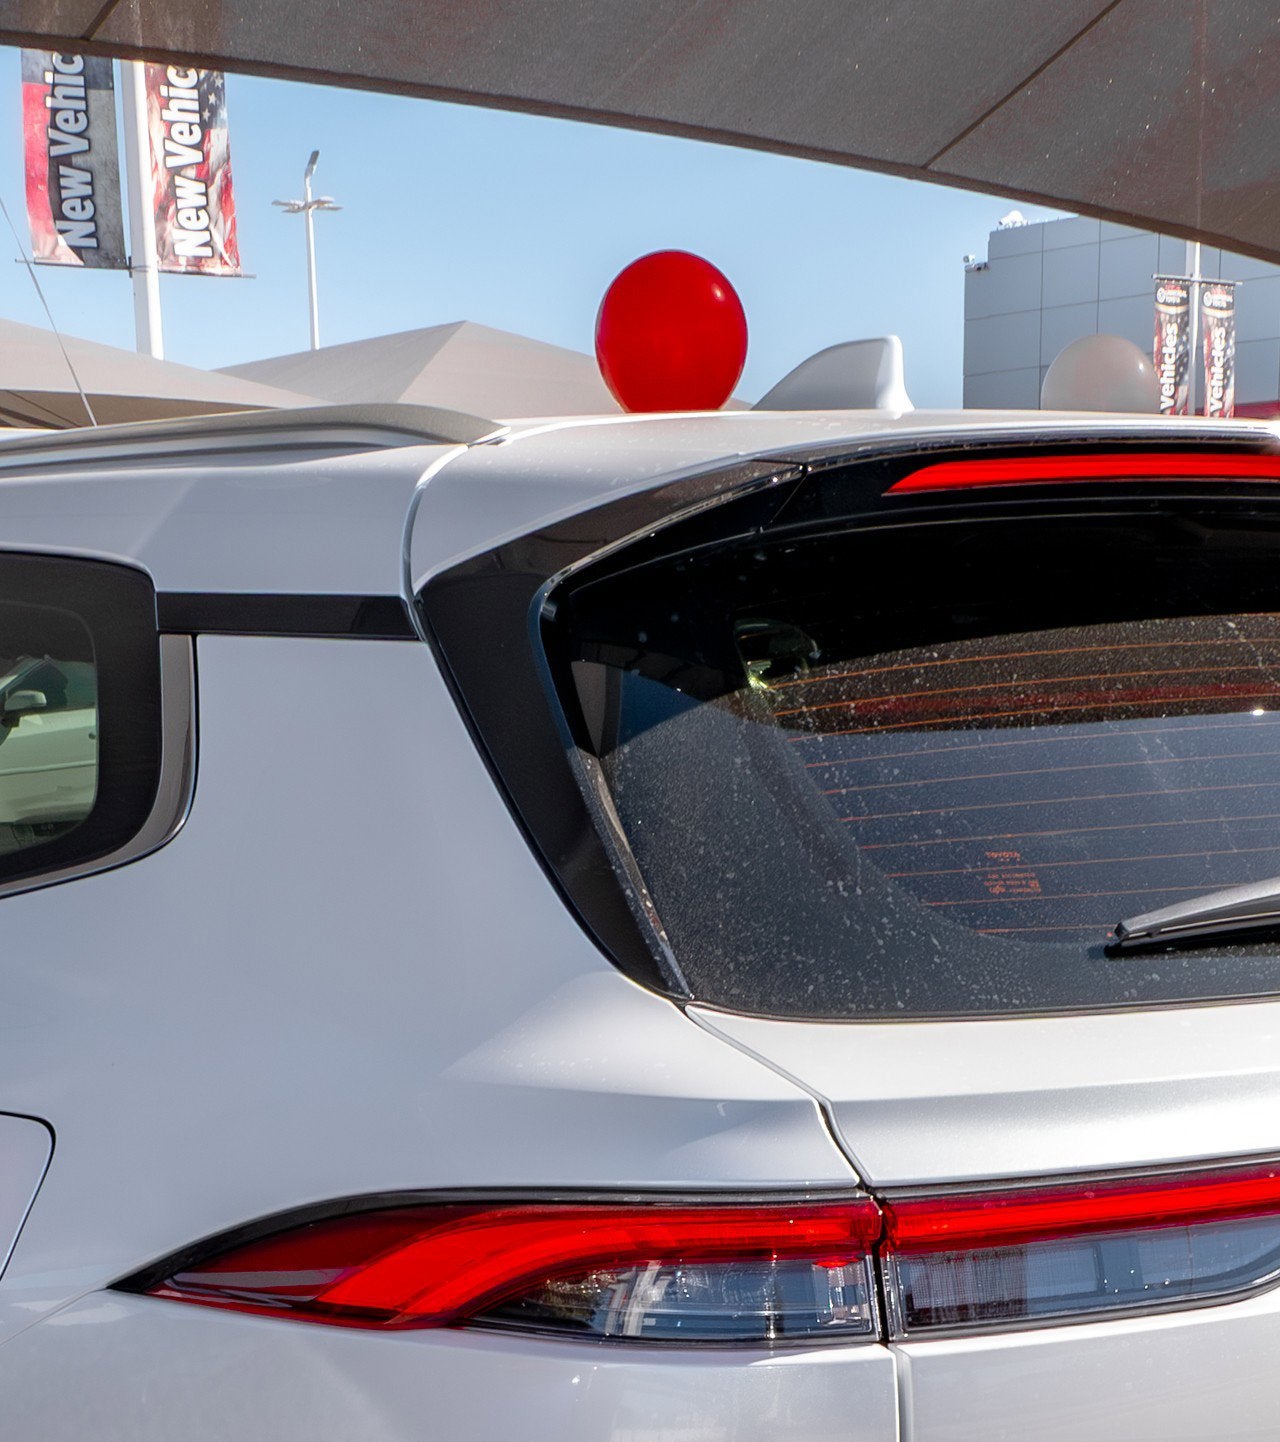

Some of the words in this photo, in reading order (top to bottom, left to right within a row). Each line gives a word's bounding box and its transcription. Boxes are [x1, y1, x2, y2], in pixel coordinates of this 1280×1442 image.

[44, 51, 91, 158] Vehic
[160, 65, 205, 169] Vehic
[54, 165, 100, 249] New
[173, 175, 214, 258] New
